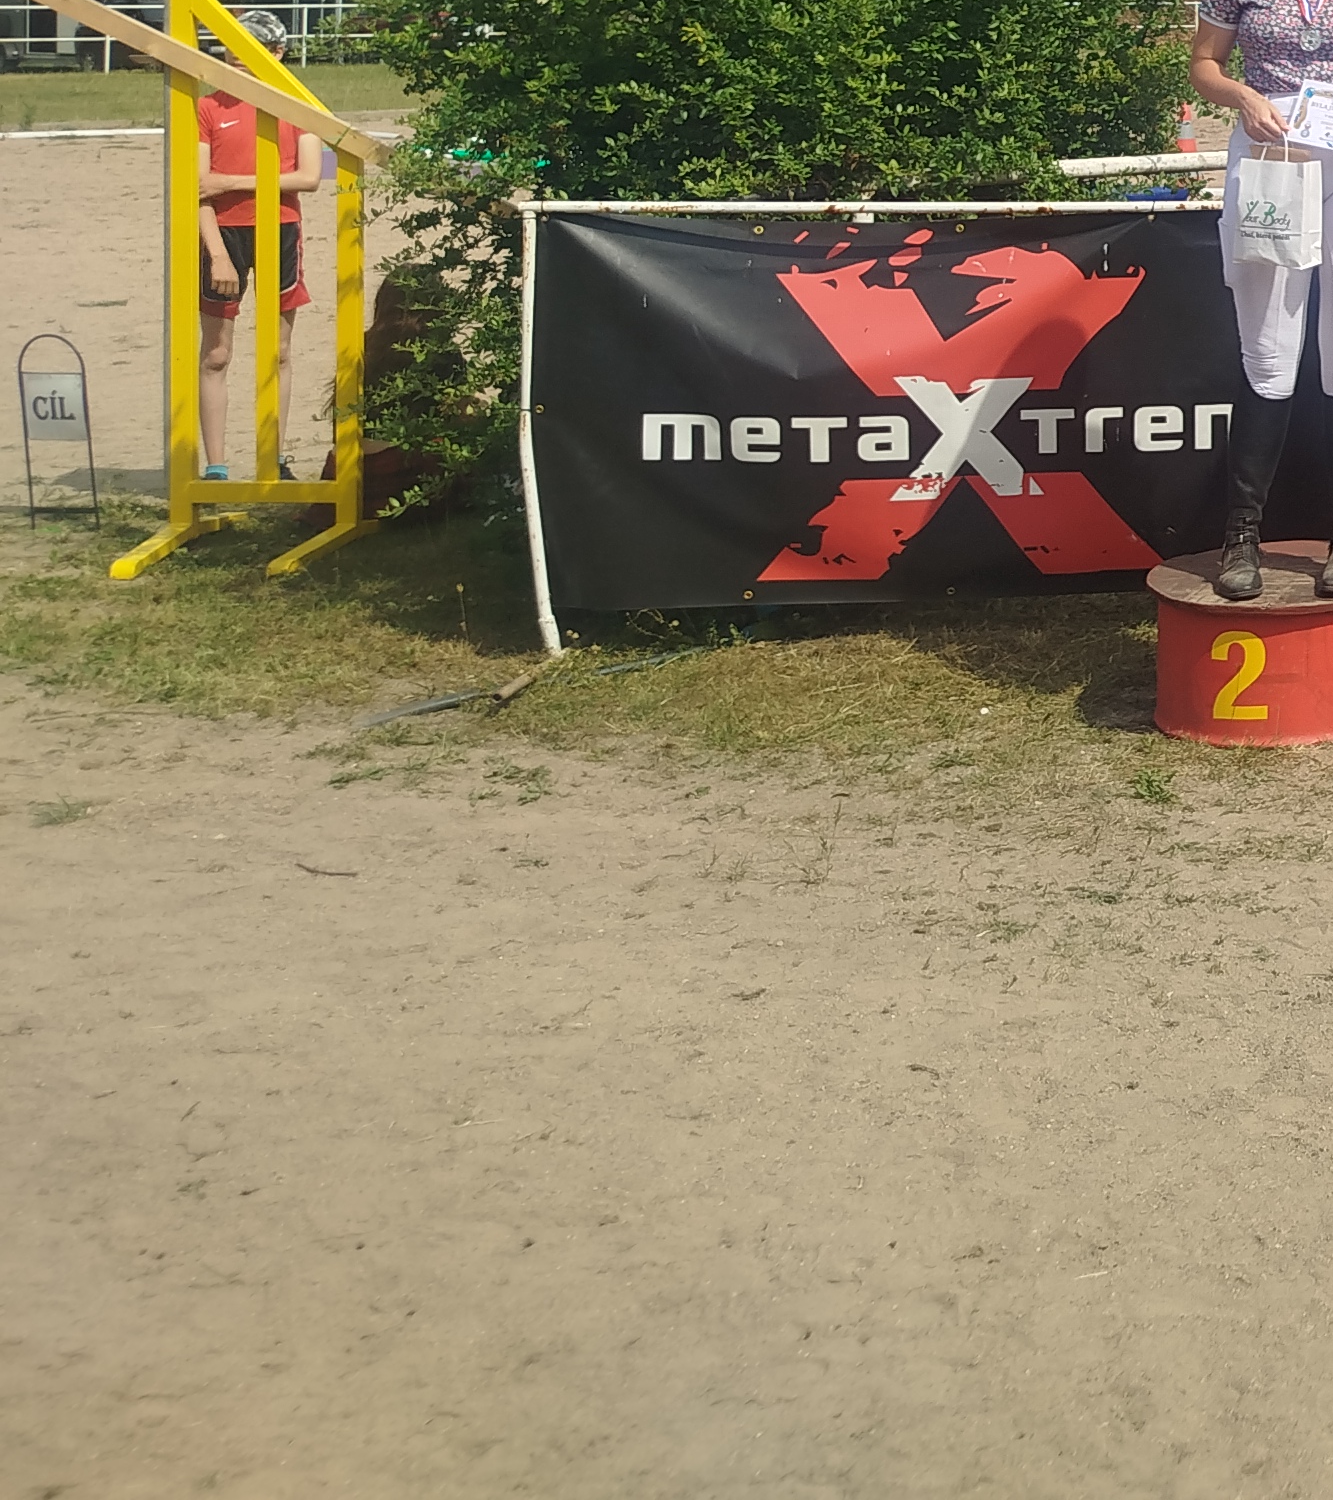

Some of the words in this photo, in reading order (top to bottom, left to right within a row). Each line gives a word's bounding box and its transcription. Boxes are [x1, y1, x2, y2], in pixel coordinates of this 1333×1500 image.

[1259, 200, 1291, 230] Body
[32, 389, 77, 420] CÍL
[1211, 631, 1269, 720] 2
